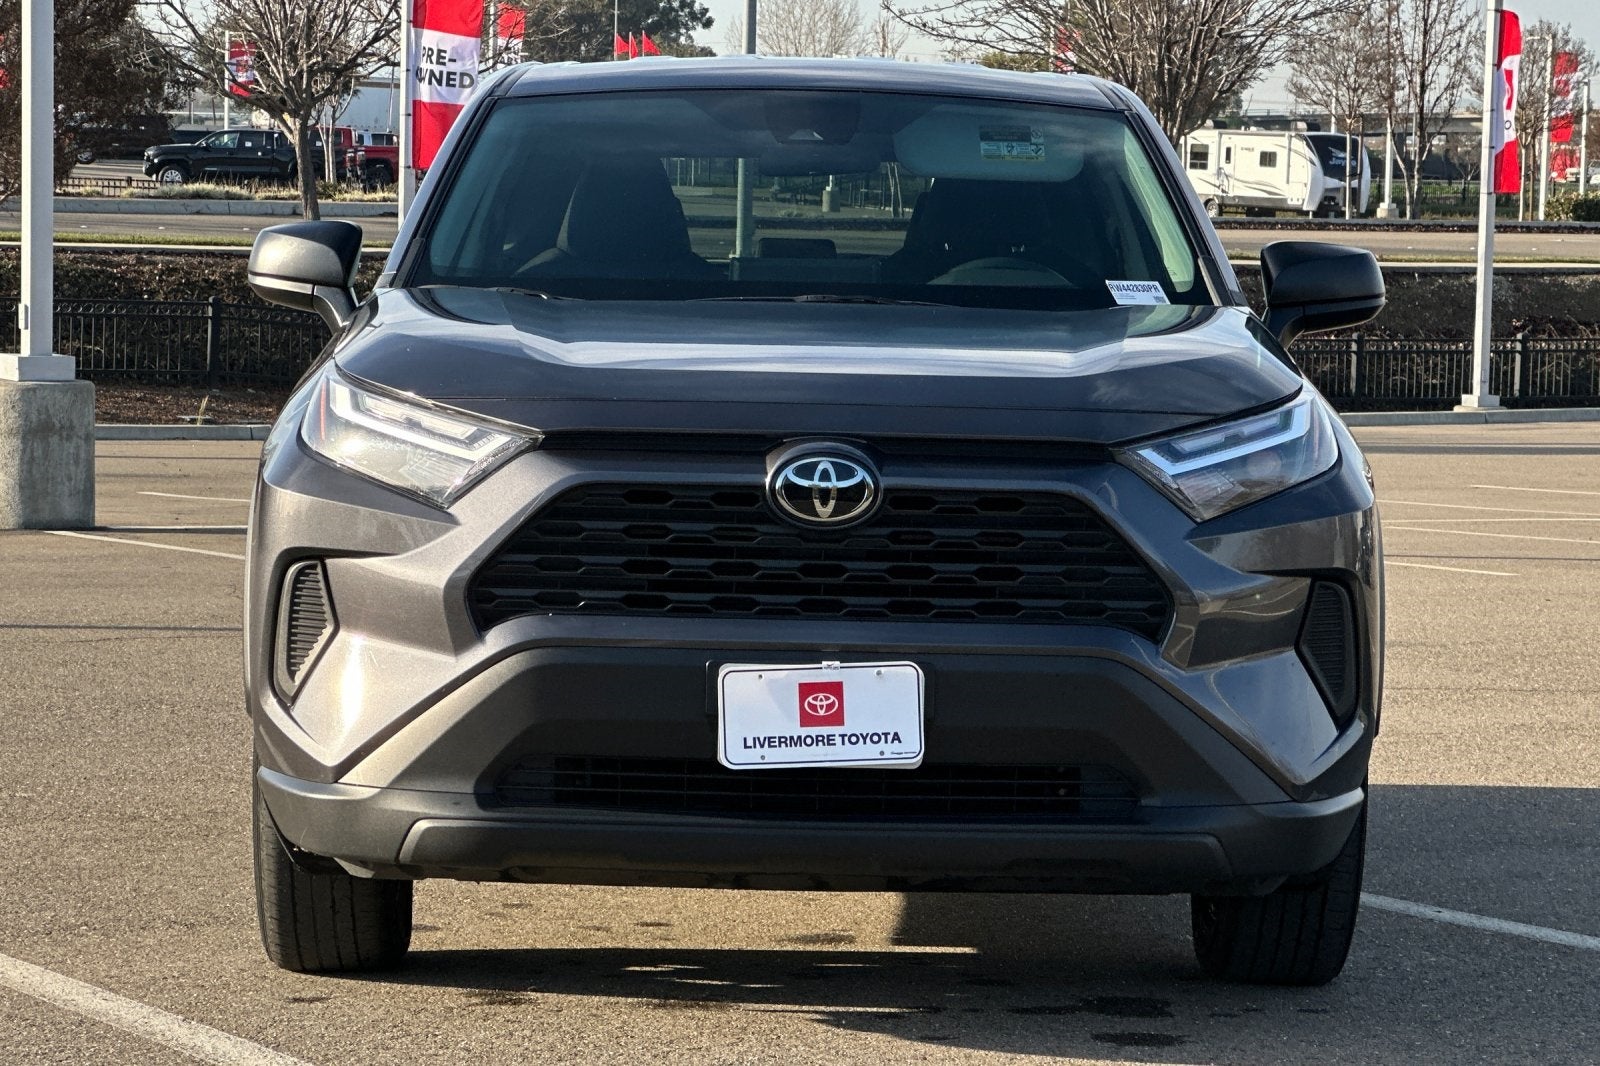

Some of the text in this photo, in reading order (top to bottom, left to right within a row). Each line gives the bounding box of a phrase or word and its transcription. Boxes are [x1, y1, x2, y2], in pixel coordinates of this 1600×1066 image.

[422, 46, 457, 66] PRE-
[1329, 158, 1357, 166] Jayo
[743, 732, 902, 749] LIVERMORE TOYOTA
